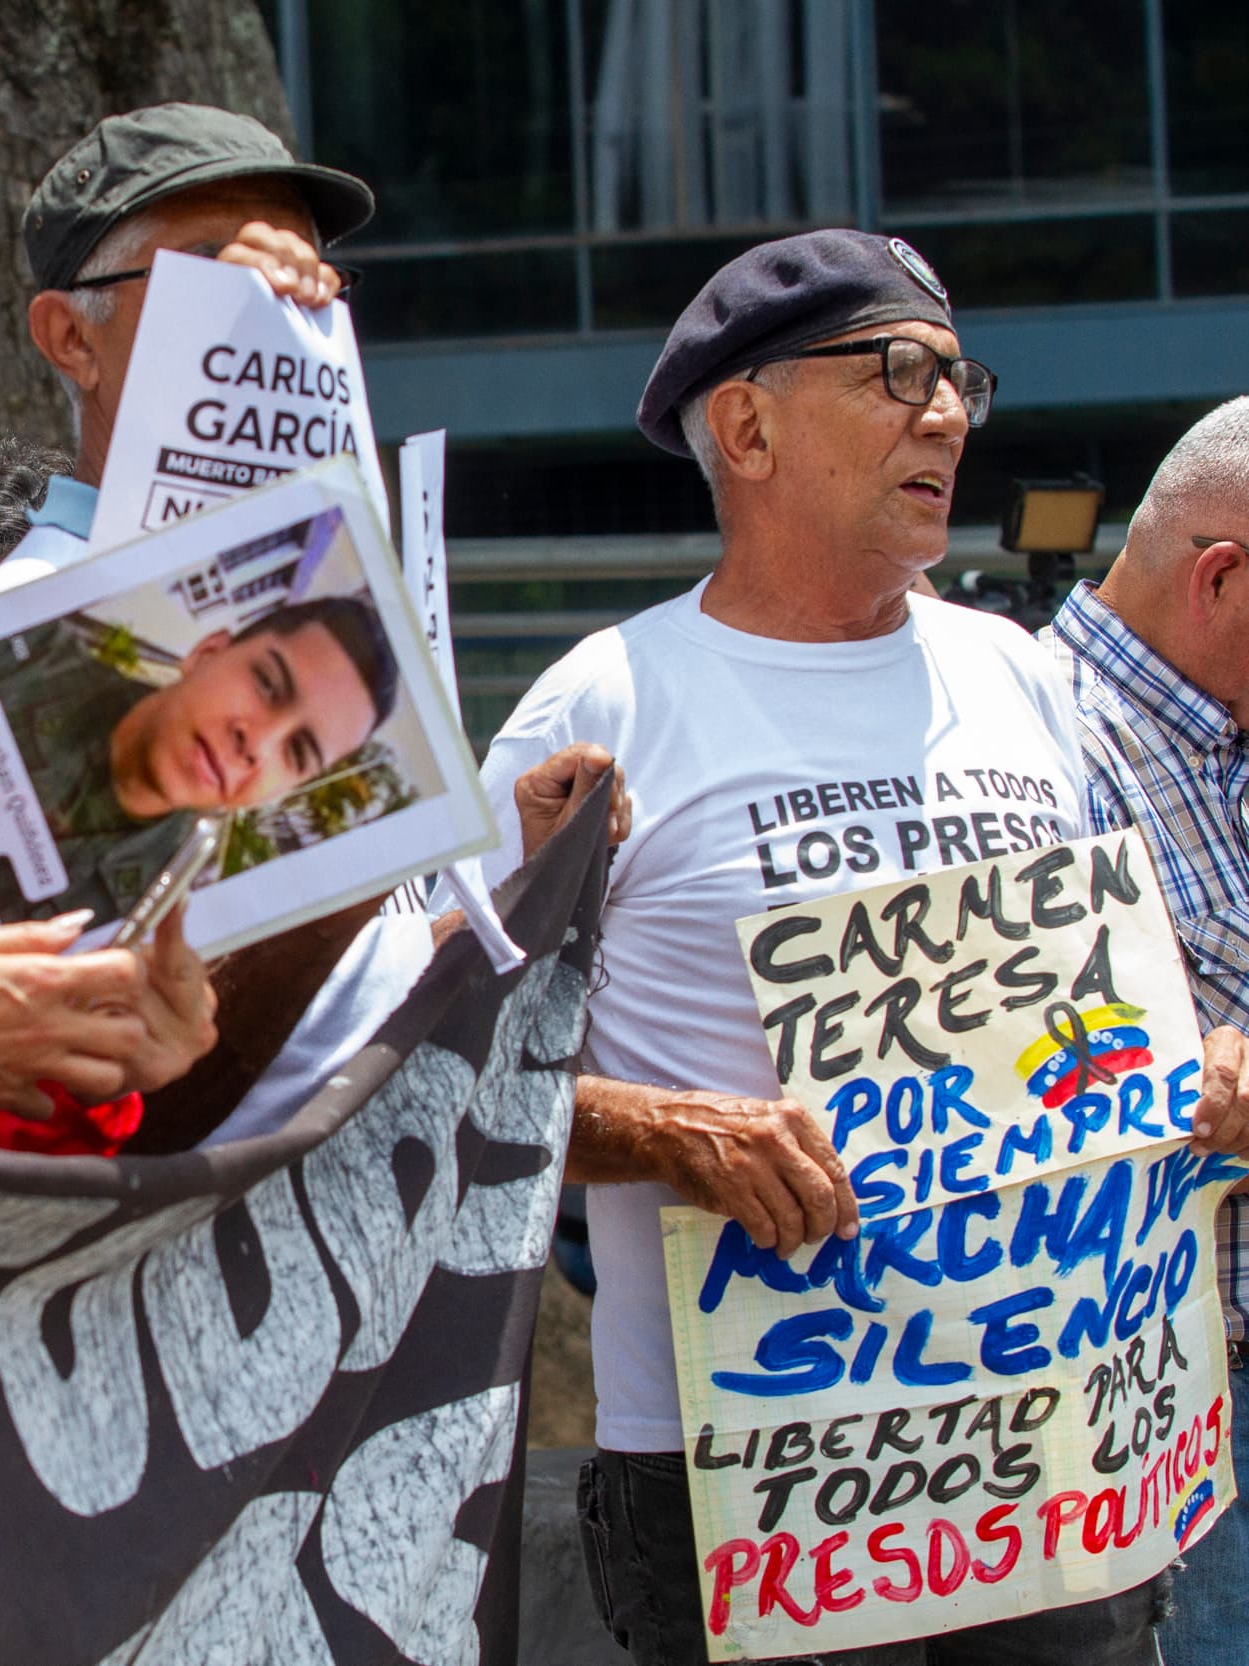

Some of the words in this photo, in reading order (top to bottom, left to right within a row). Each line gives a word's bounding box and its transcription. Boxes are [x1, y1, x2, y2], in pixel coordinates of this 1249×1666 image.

[187, 399, 358, 464] GARCÍA
[202, 345, 350, 405] CARLOS
[166, 452, 249, 484] MUERTO
[748, 776, 925, 836] LIBEREN
[936, 771, 965, 802] A
[963, 768, 1057, 809] TODOS
[756, 825, 880, 889] LOS
[749, 836, 1141, 984] CARMEN
[761, 923, 1130, 1085] TERESA
[826, 1064, 990, 1155] POR
[850, 1060, 1202, 1217] SIEMPRE
[699, 1157, 1134, 1314] MARCHA
[710, 1228, 1198, 1397] SILENCIO
[693, 1387, 1060, 1471] LIBERTAD
[1083, 1313, 1188, 1427] PARA
[753, 1444, 1041, 1532] TODOS
[1091, 1384, 1176, 1474] LOS
[704, 1503, 1023, 1636] PRESOS
